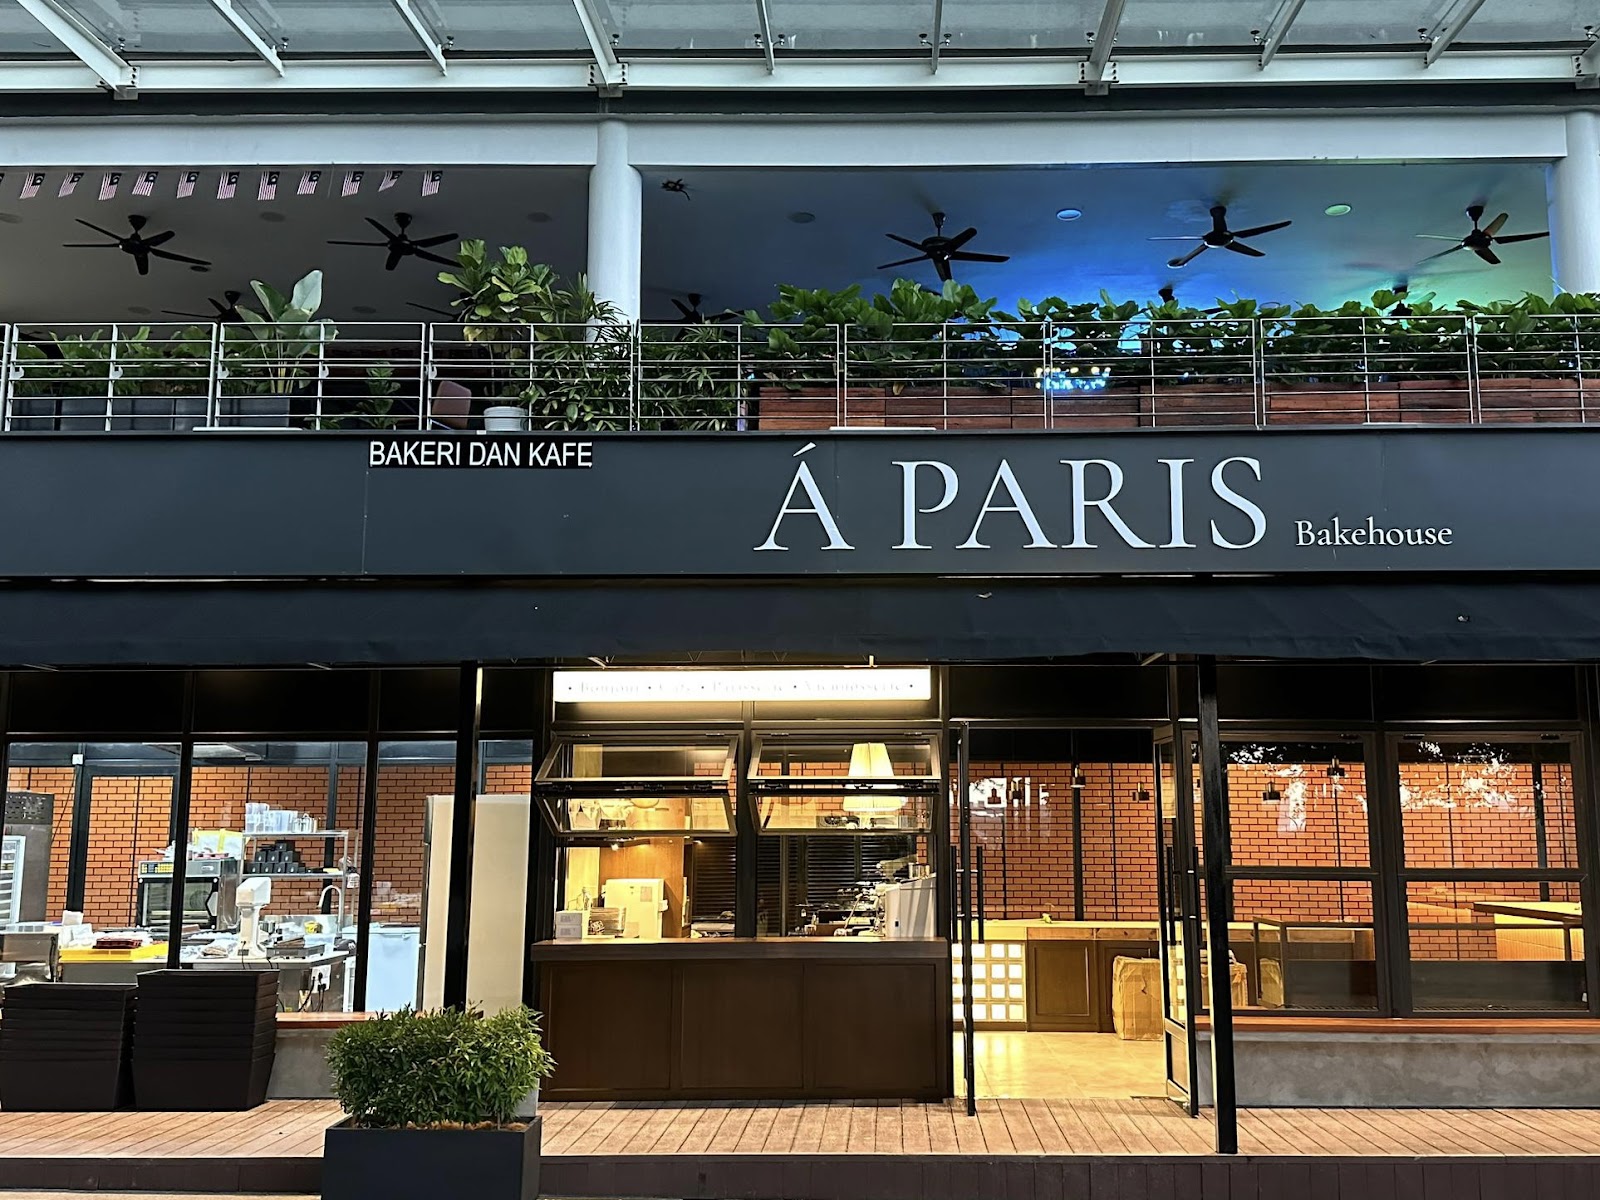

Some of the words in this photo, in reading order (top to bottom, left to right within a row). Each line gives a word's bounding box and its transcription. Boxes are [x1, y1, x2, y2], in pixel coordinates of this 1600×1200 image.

[369, 441, 461, 466] BAKERI
[469, 442, 521, 466] DAN
[529, 442, 593, 466] KAFE
[753, 442, 856, 550] Á
[891, 456, 1267, 550] PARIS
[1294, 516, 1453, 546] Bakehouse
